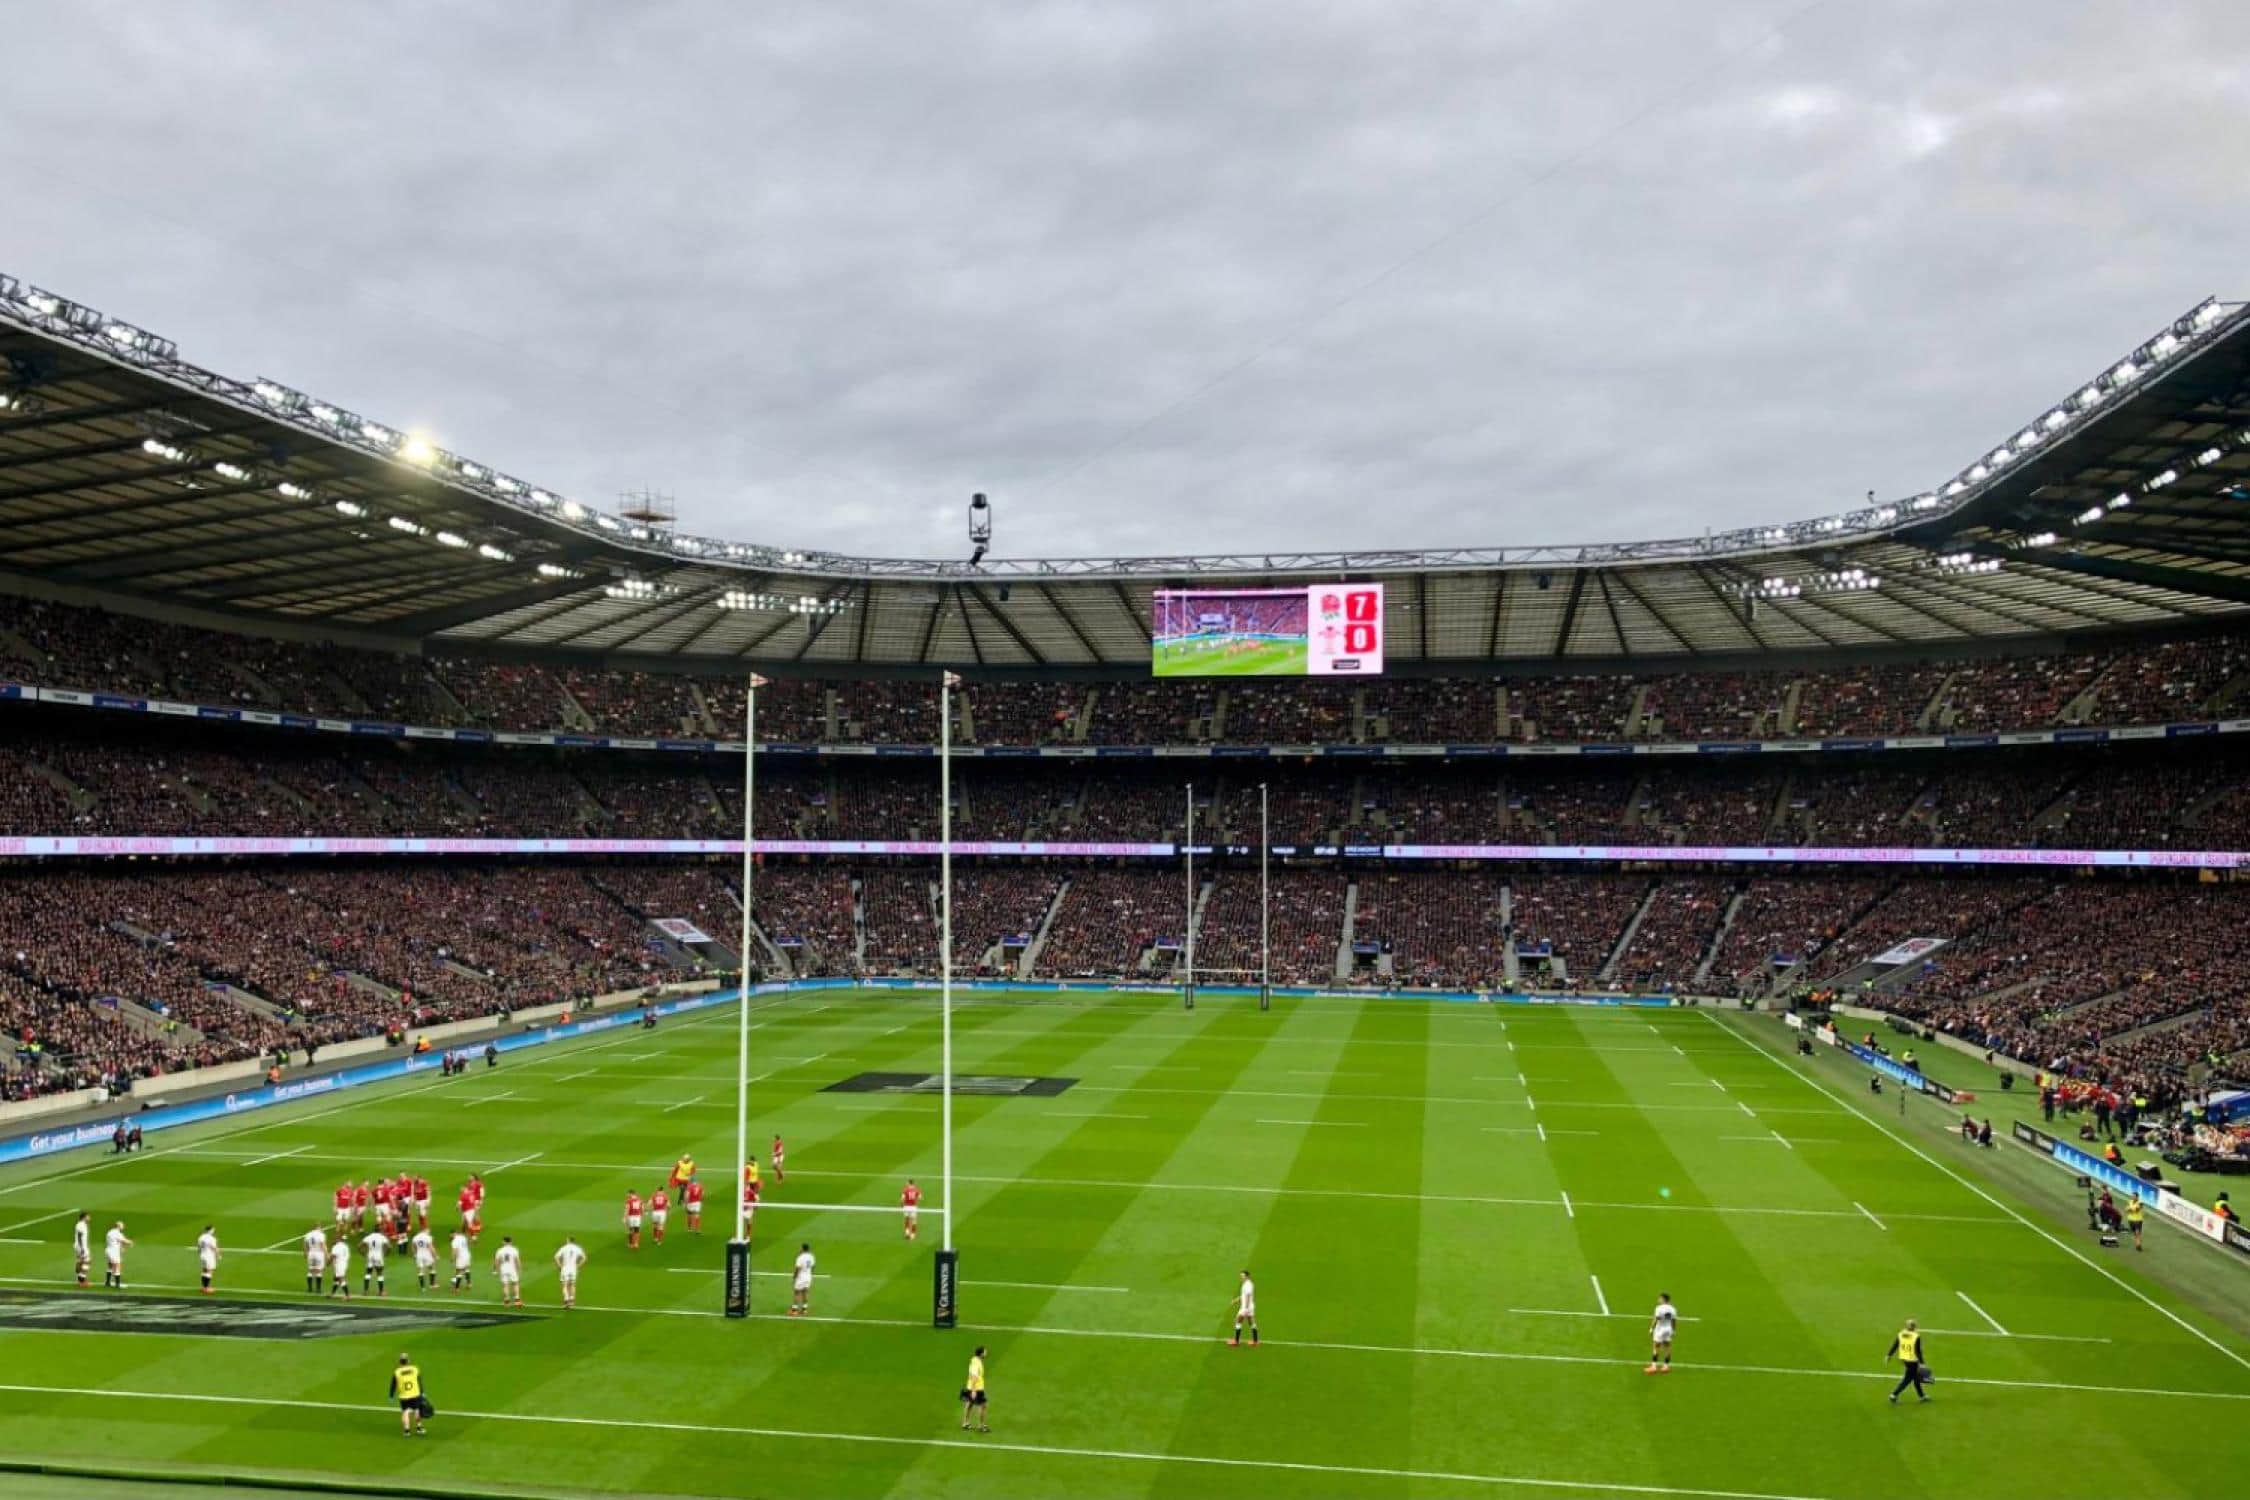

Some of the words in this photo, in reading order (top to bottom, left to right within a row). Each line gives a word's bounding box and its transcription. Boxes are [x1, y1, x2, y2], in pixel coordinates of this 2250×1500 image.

[1354, 594, 1368, 619] 7
[1353, 627, 1368, 650] 0
[31, 1135, 49, 1151] Get
[50, 1131, 75, 1148] your
